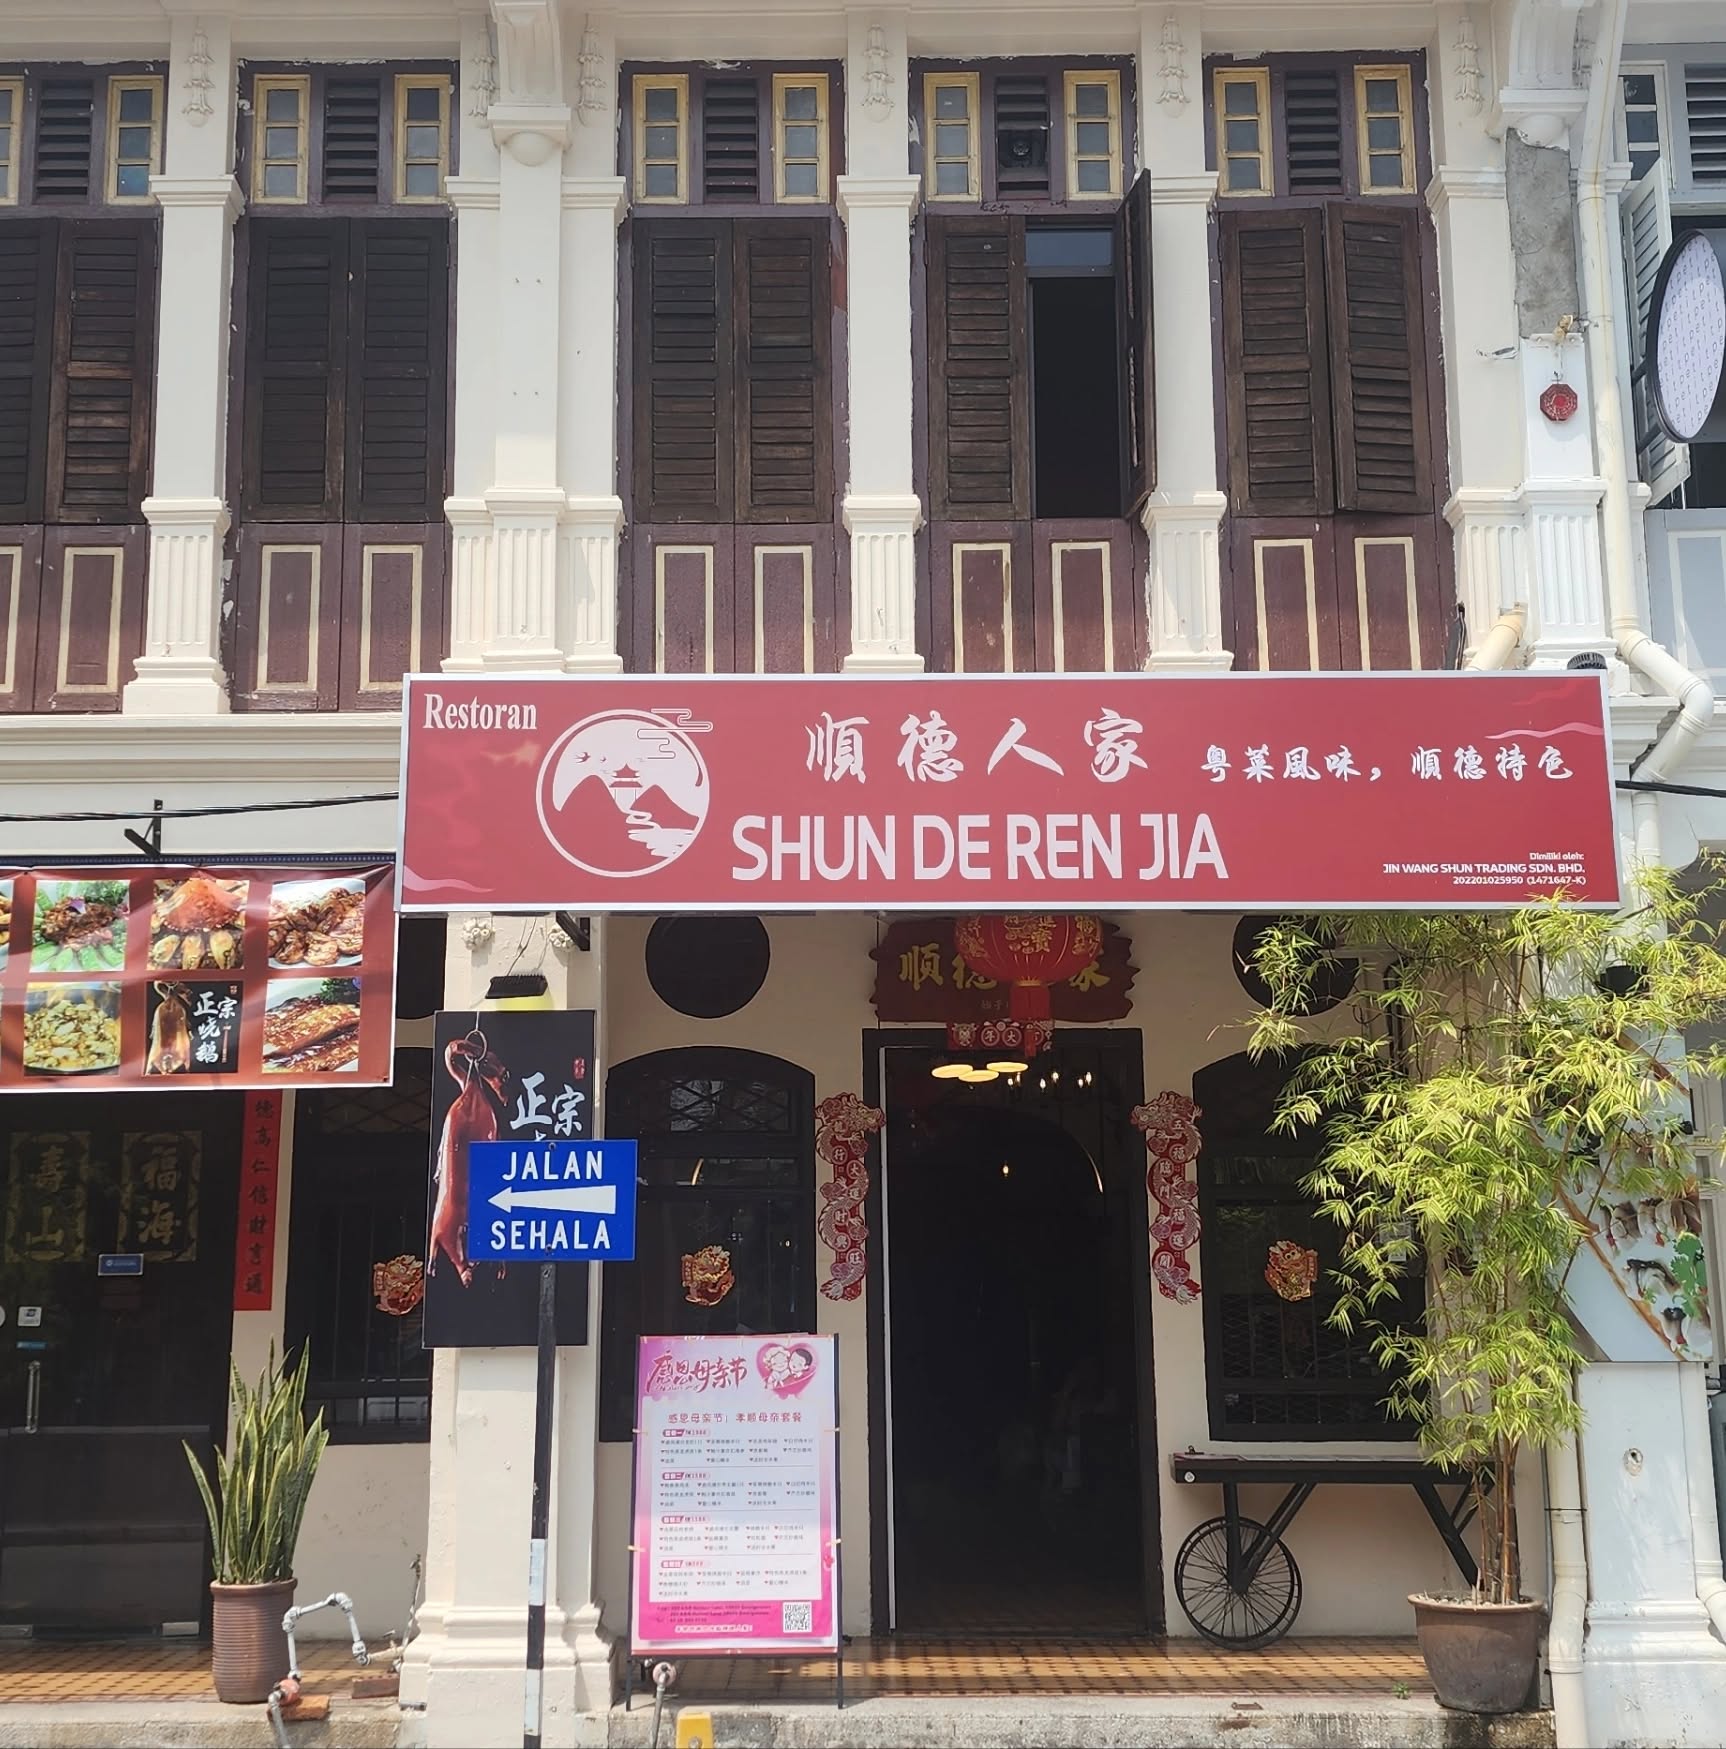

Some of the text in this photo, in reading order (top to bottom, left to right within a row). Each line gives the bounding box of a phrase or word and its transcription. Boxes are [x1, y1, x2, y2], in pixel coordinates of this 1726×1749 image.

[423, 693, 538, 732] Restoran
[804, 706, 1149, 785] 順德人家
[731, 813, 1229, 882] SHUN DE REN JIA
[1383, 863, 1586, 874] JIN WANG SHUN TRADING SDN. BHD.
[1452, 875, 1524, 886] 202201025950
[510, 1071, 586, 1137] 正宗
[502, 1150, 603, 1181] JALAN
[489, 1219, 611, 1251] SEHALA
